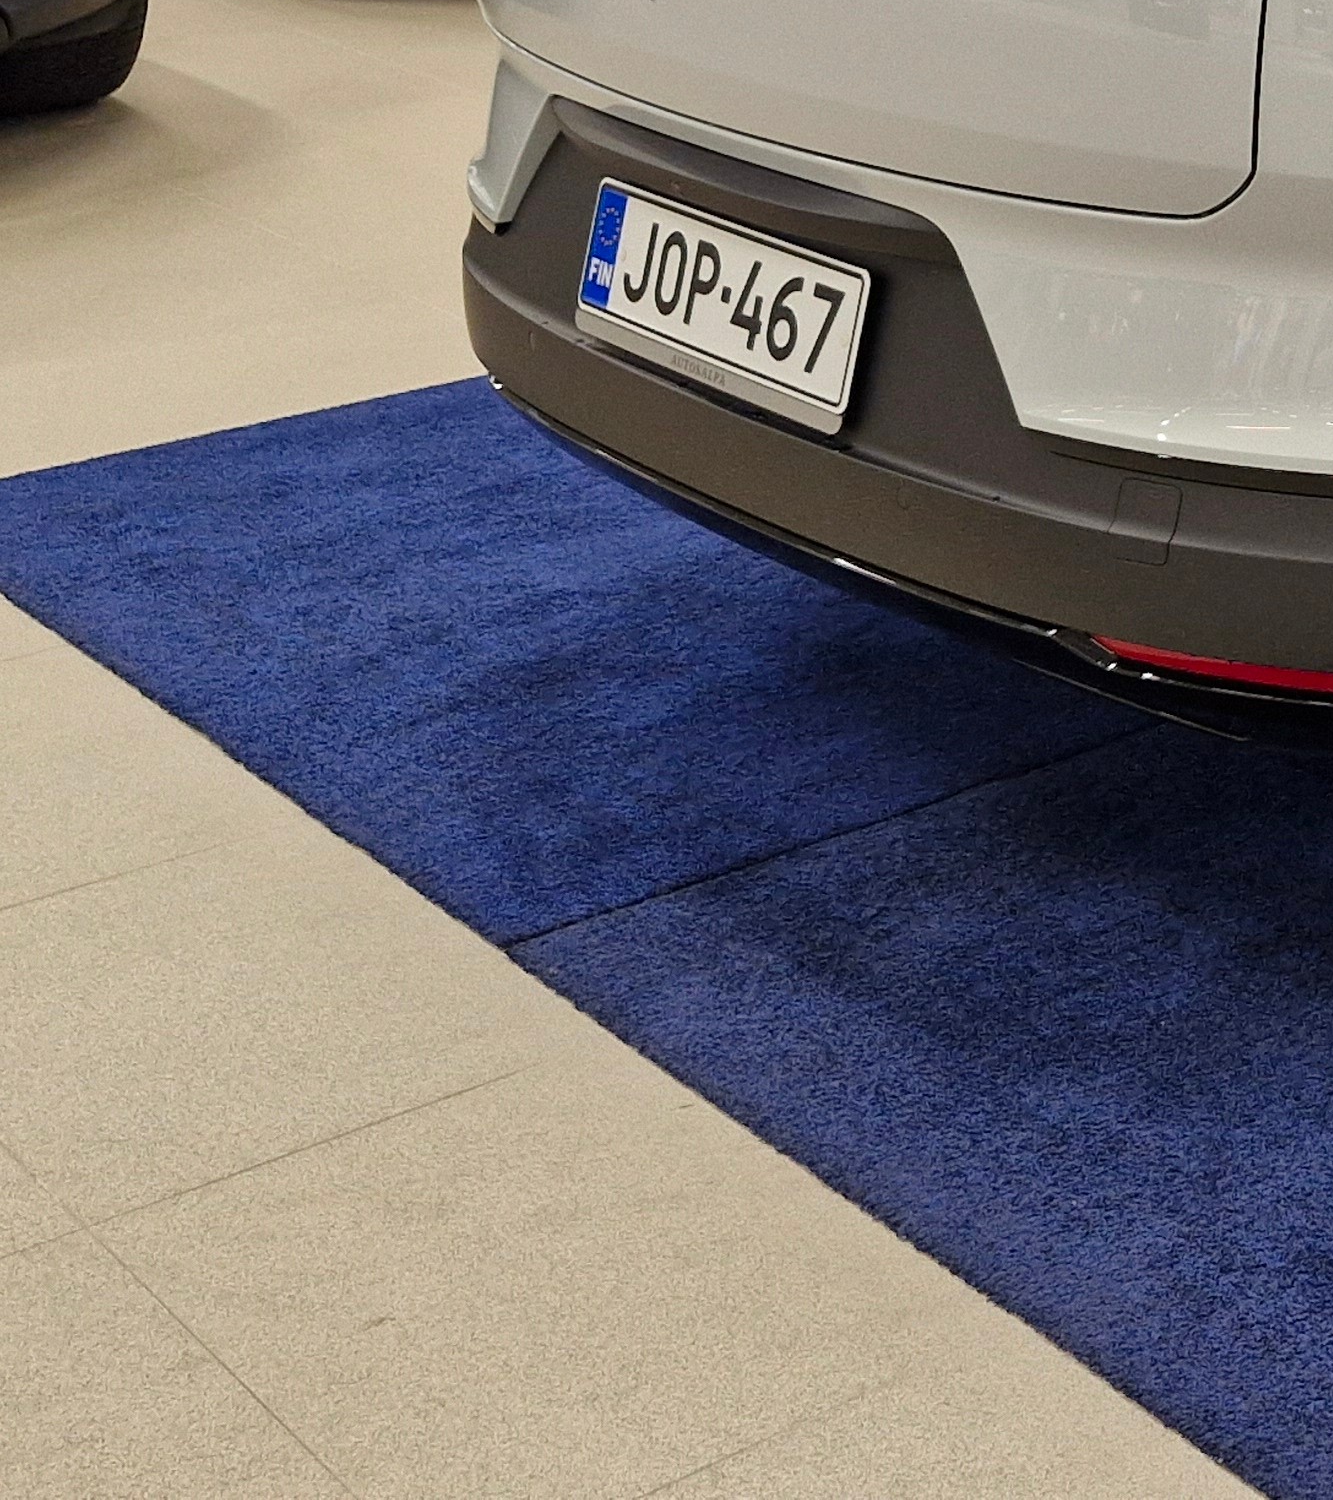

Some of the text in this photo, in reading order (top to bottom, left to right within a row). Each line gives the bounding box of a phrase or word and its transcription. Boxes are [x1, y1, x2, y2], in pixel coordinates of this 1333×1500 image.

[587, 256, 616, 289] FIN
[623, 221, 847, 375] JOP-467
[671, 353, 727, 388] AUTOSALPA
